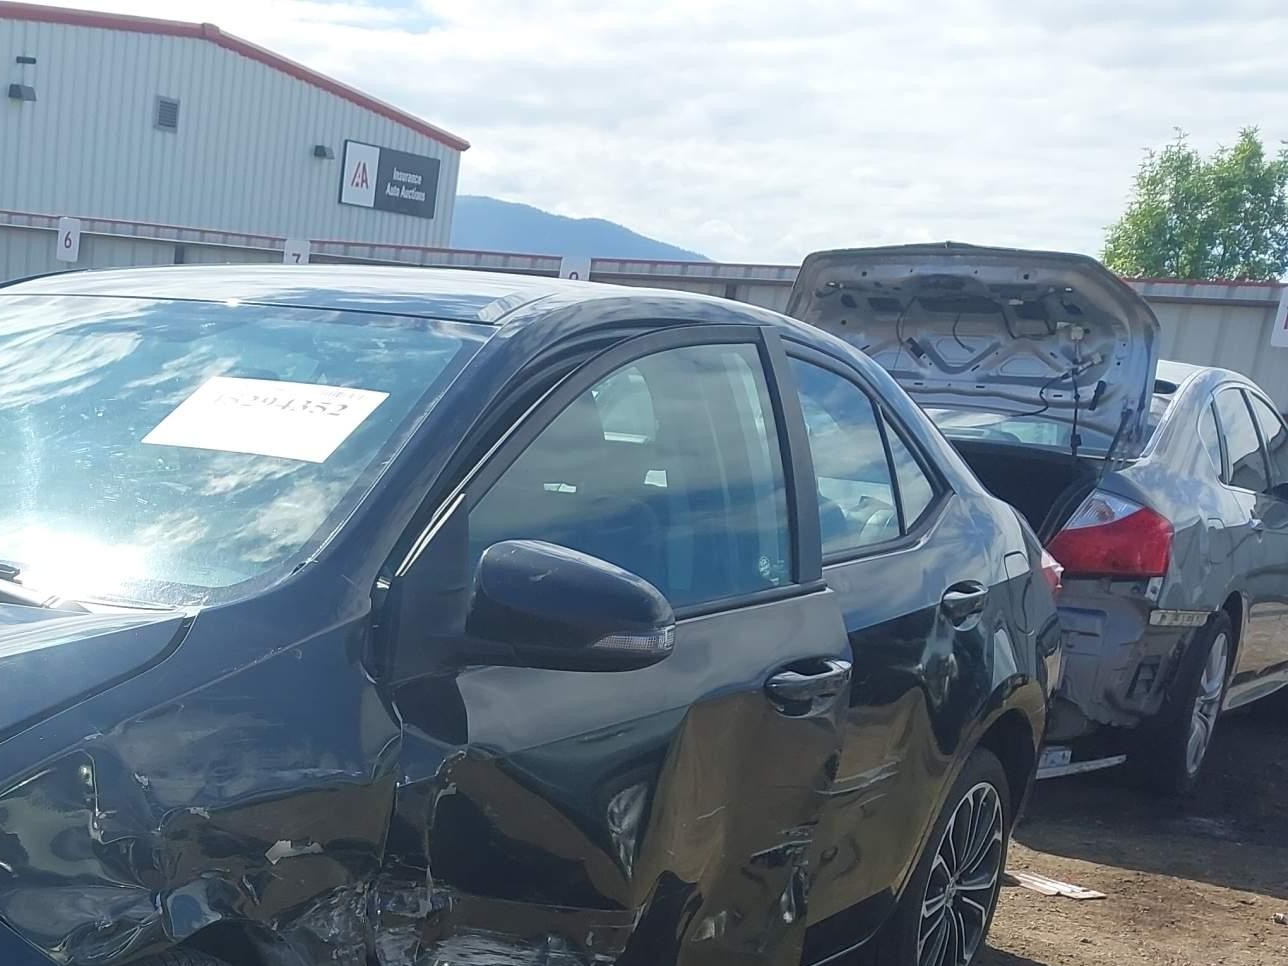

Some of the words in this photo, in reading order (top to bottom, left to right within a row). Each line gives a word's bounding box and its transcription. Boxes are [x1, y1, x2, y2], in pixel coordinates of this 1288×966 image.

[393, 167, 422, 184] Insurance
[385, 182, 400, 197] Auto
[400, 185, 426, 202] Auctions
[64, 231, 72, 248] 6
